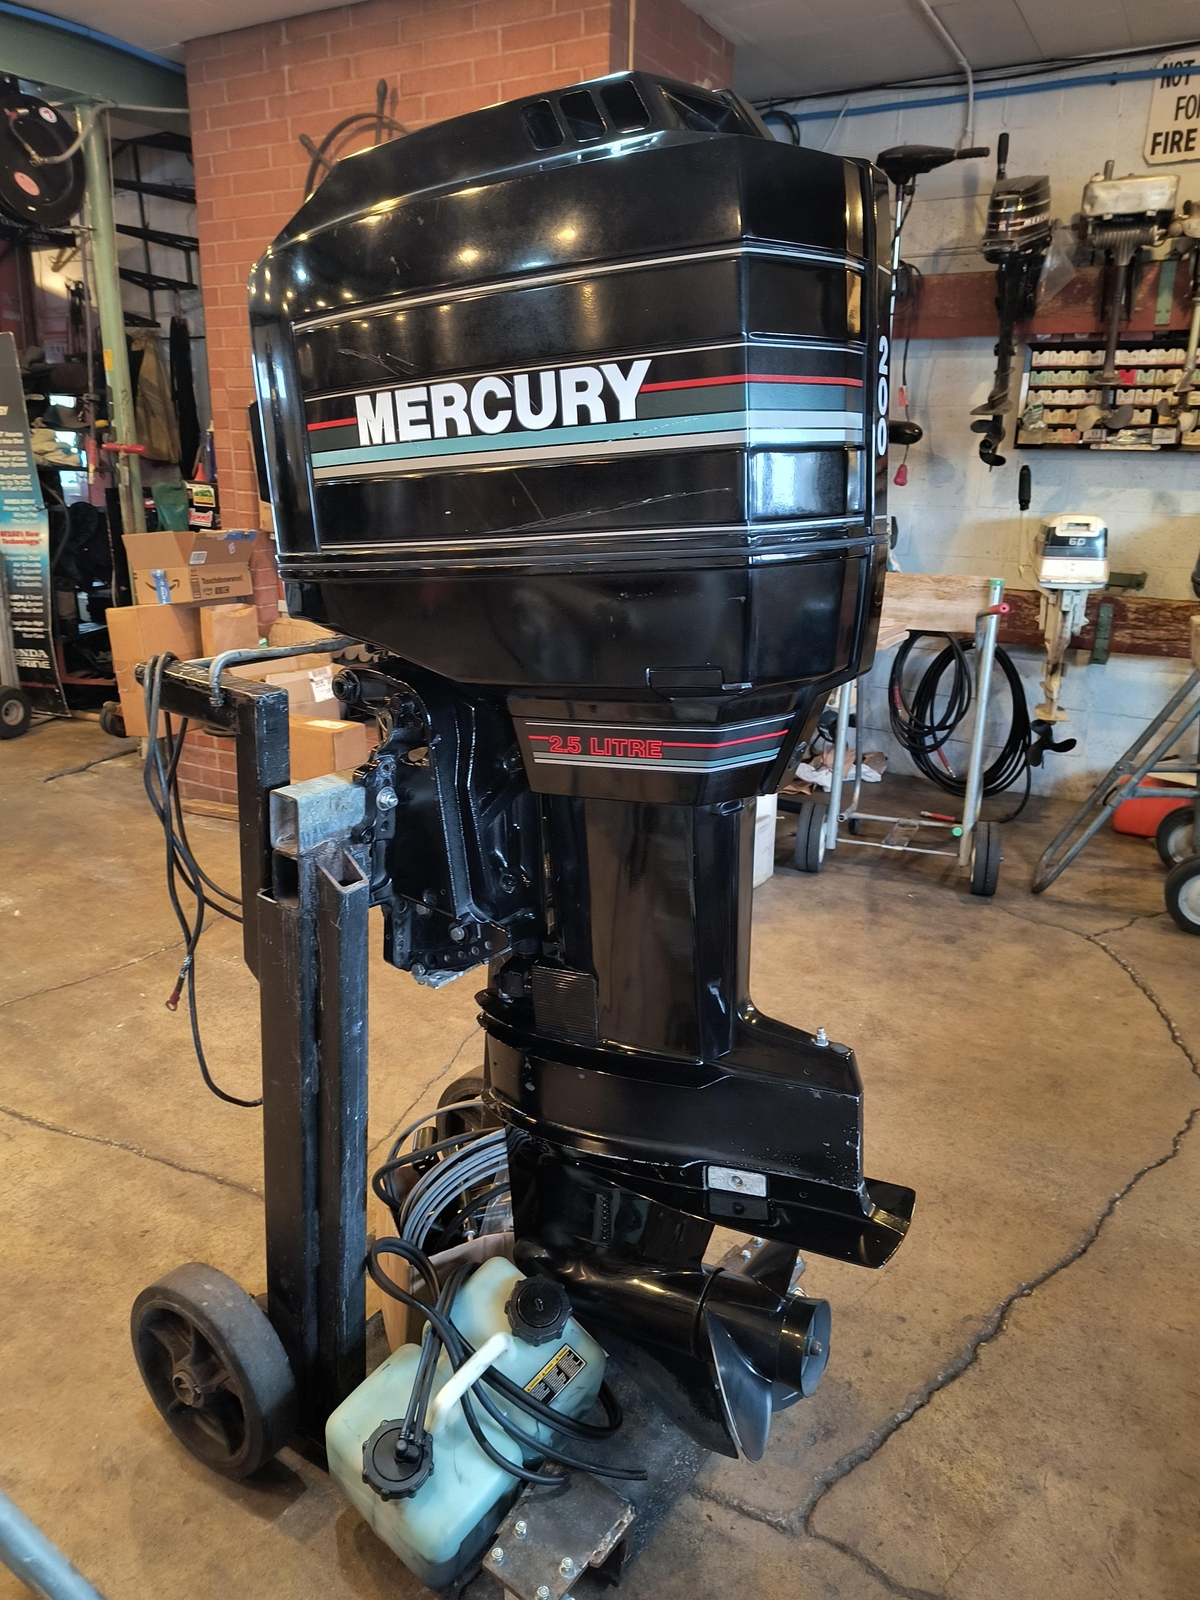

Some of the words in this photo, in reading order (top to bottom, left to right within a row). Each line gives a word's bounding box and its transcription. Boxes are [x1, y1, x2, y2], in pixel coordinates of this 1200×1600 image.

[1160, 59, 1196, 89] NOT
[1150, 128, 1198, 156] FIRE
[355, 360, 651, 446] MERCURY
[876, 335, 889, 456] 200
[13, 648, 49, 658] ONDA
[15, 660, 51, 669] ARINE
[549, 735, 582, 754] 2.5
[590, 737, 662, 759] LITRE
